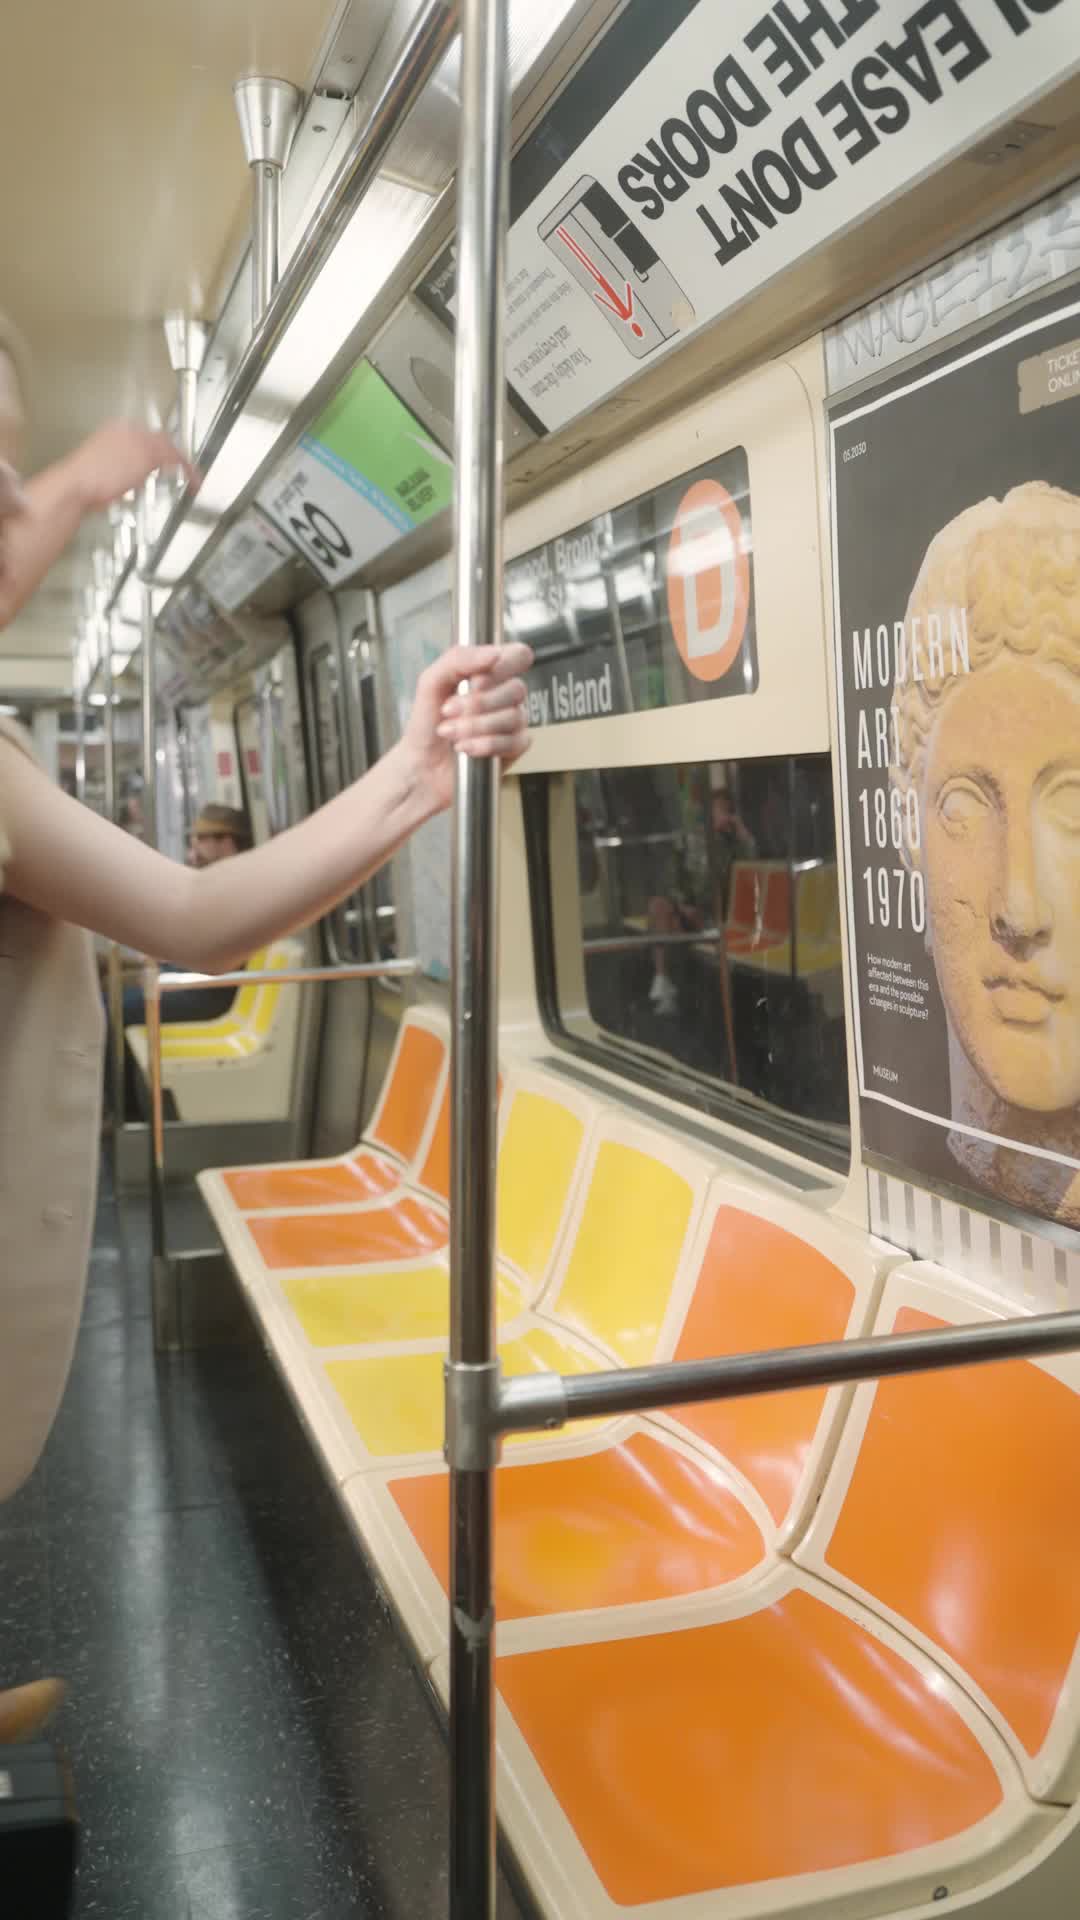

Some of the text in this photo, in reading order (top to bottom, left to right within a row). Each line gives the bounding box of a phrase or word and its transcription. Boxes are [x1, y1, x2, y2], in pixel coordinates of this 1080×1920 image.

[616, 54, 772, 220] DOORS
[696, 0, 1065, 267] EASE DON'T
[1047, 350, 1080, 375] TICKE
[1047, 367, 1080, 393] ONLIN
[842, 441, 867, 463] 05.2030
[681, 506, 736, 659] D
[852, 607, 970, 691] MODERN
[551, 662, 613, 720] Island
[857, 706, 901, 769] ART
[858, 787, 922, 851] 1860
[862, 866, 926, 934] 1970
[867, 952, 911, 973] How modern art
[868, 966, 929, 991] affected between this
[868, 983, 924, 1005] era and the possible
[869, 993, 929, 1020] changes in sculpture?
[872, 1064, 899, 1083] MUSEUM
